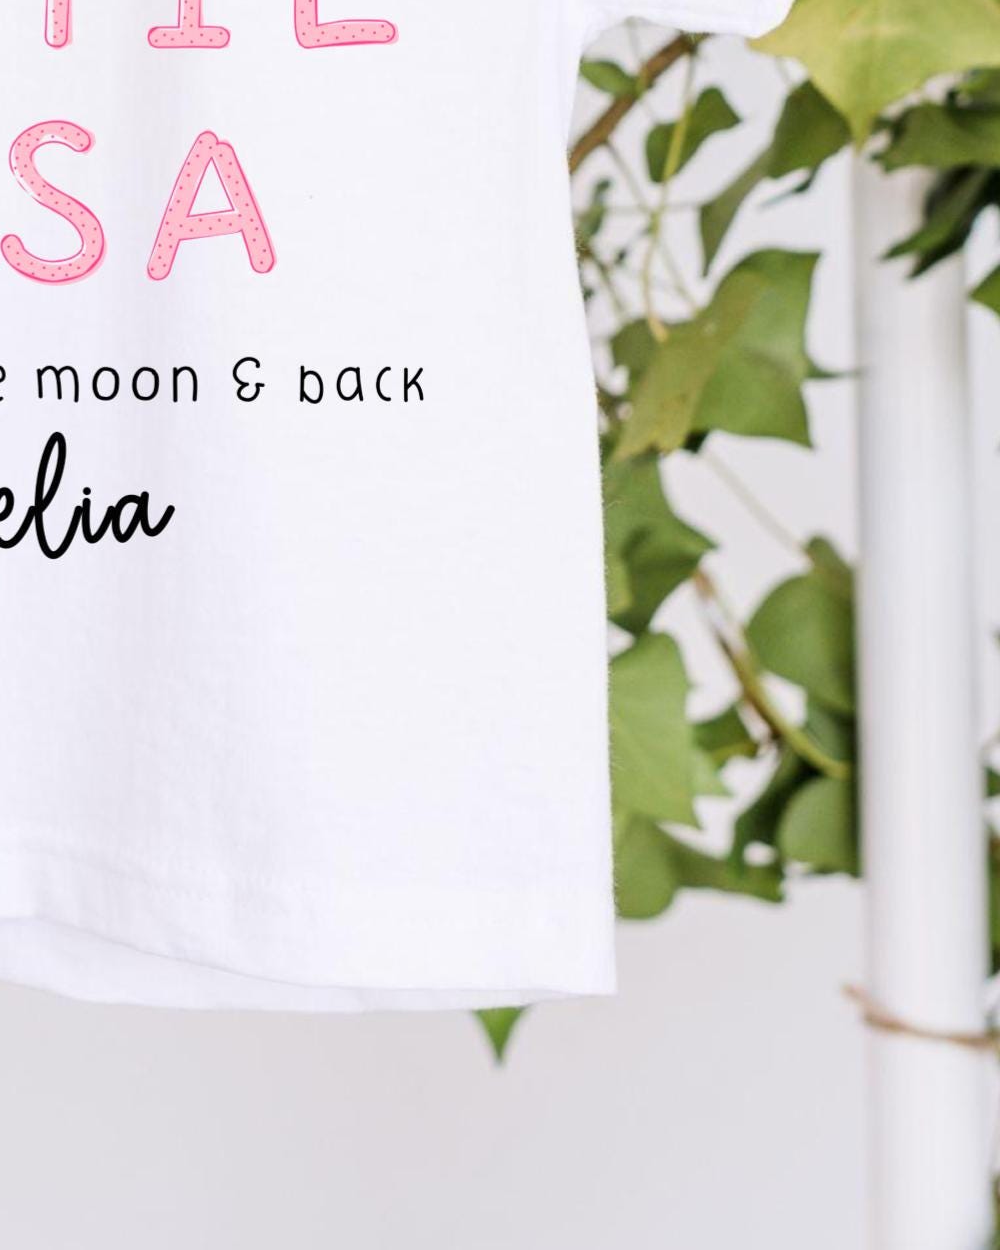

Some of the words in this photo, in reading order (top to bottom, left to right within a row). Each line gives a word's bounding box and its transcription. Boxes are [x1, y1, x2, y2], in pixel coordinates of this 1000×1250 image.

[35, 364, 199, 404] moon
[231, 356, 266, 403] &
[299, 364, 425, 405] back
